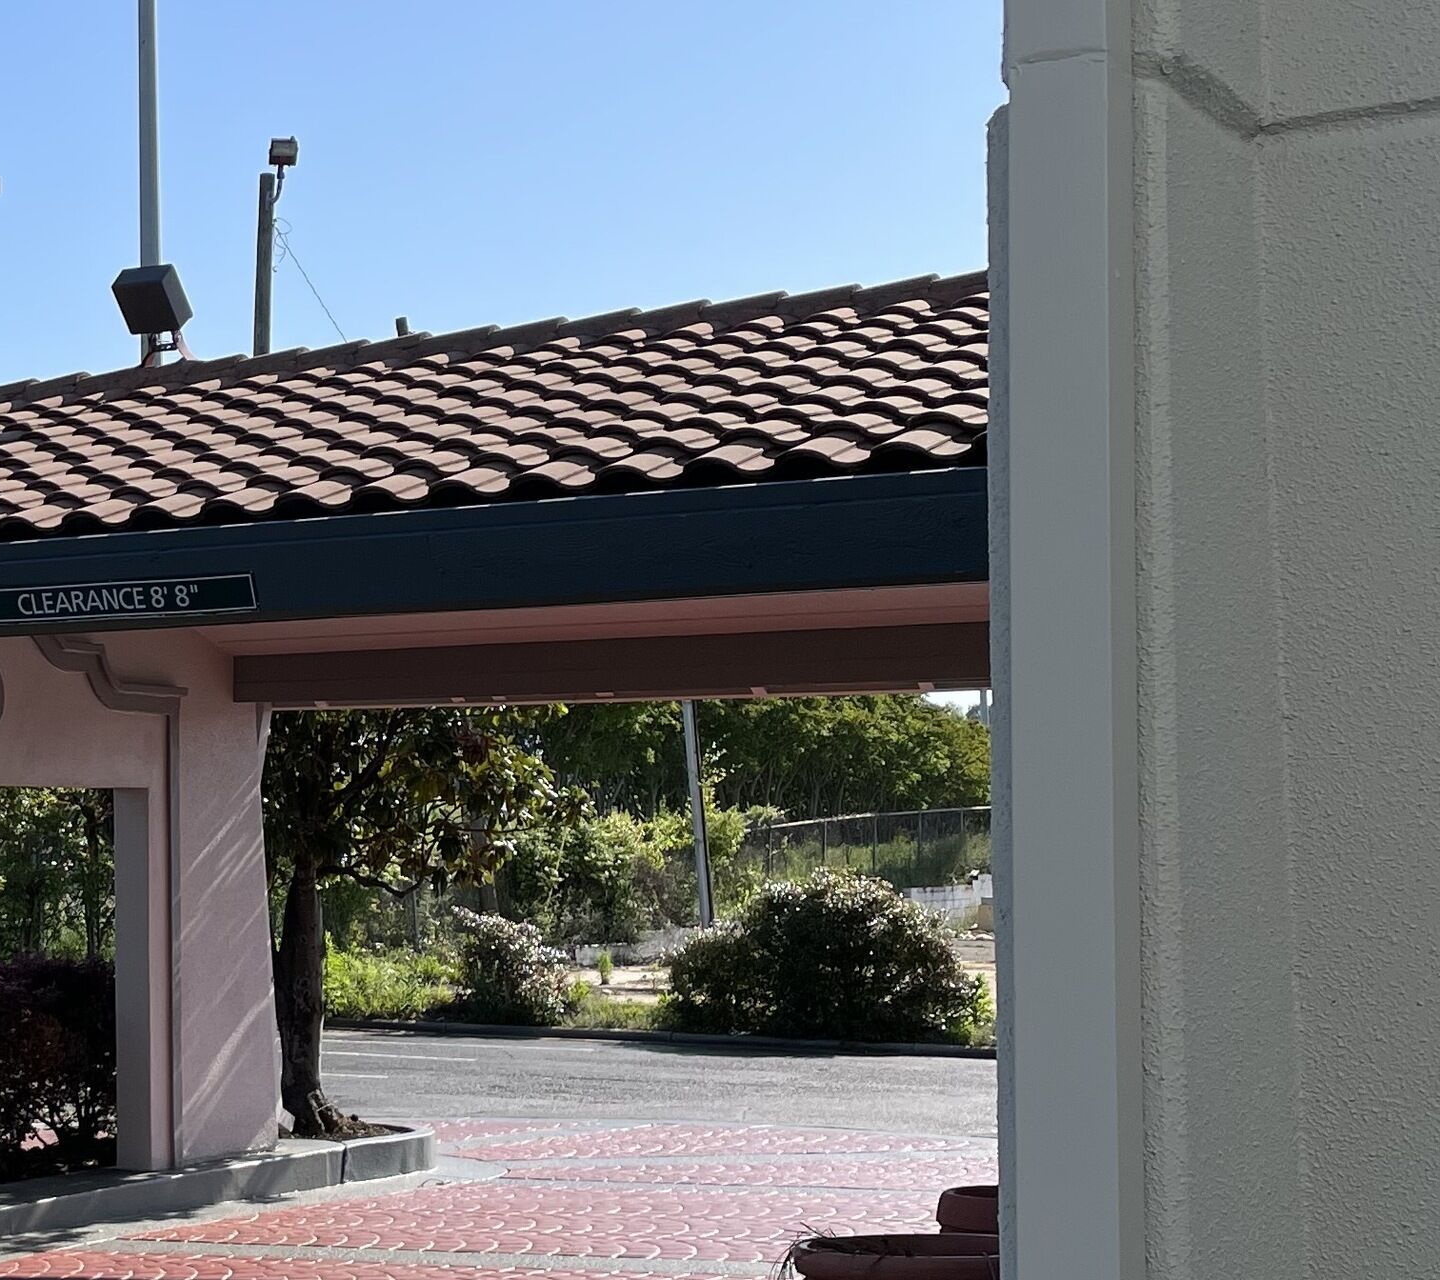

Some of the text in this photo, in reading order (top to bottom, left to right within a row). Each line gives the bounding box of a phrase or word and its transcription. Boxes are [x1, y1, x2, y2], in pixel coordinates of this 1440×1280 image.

[17, 584, 199, 615] CLEARANCE 8' 8"
